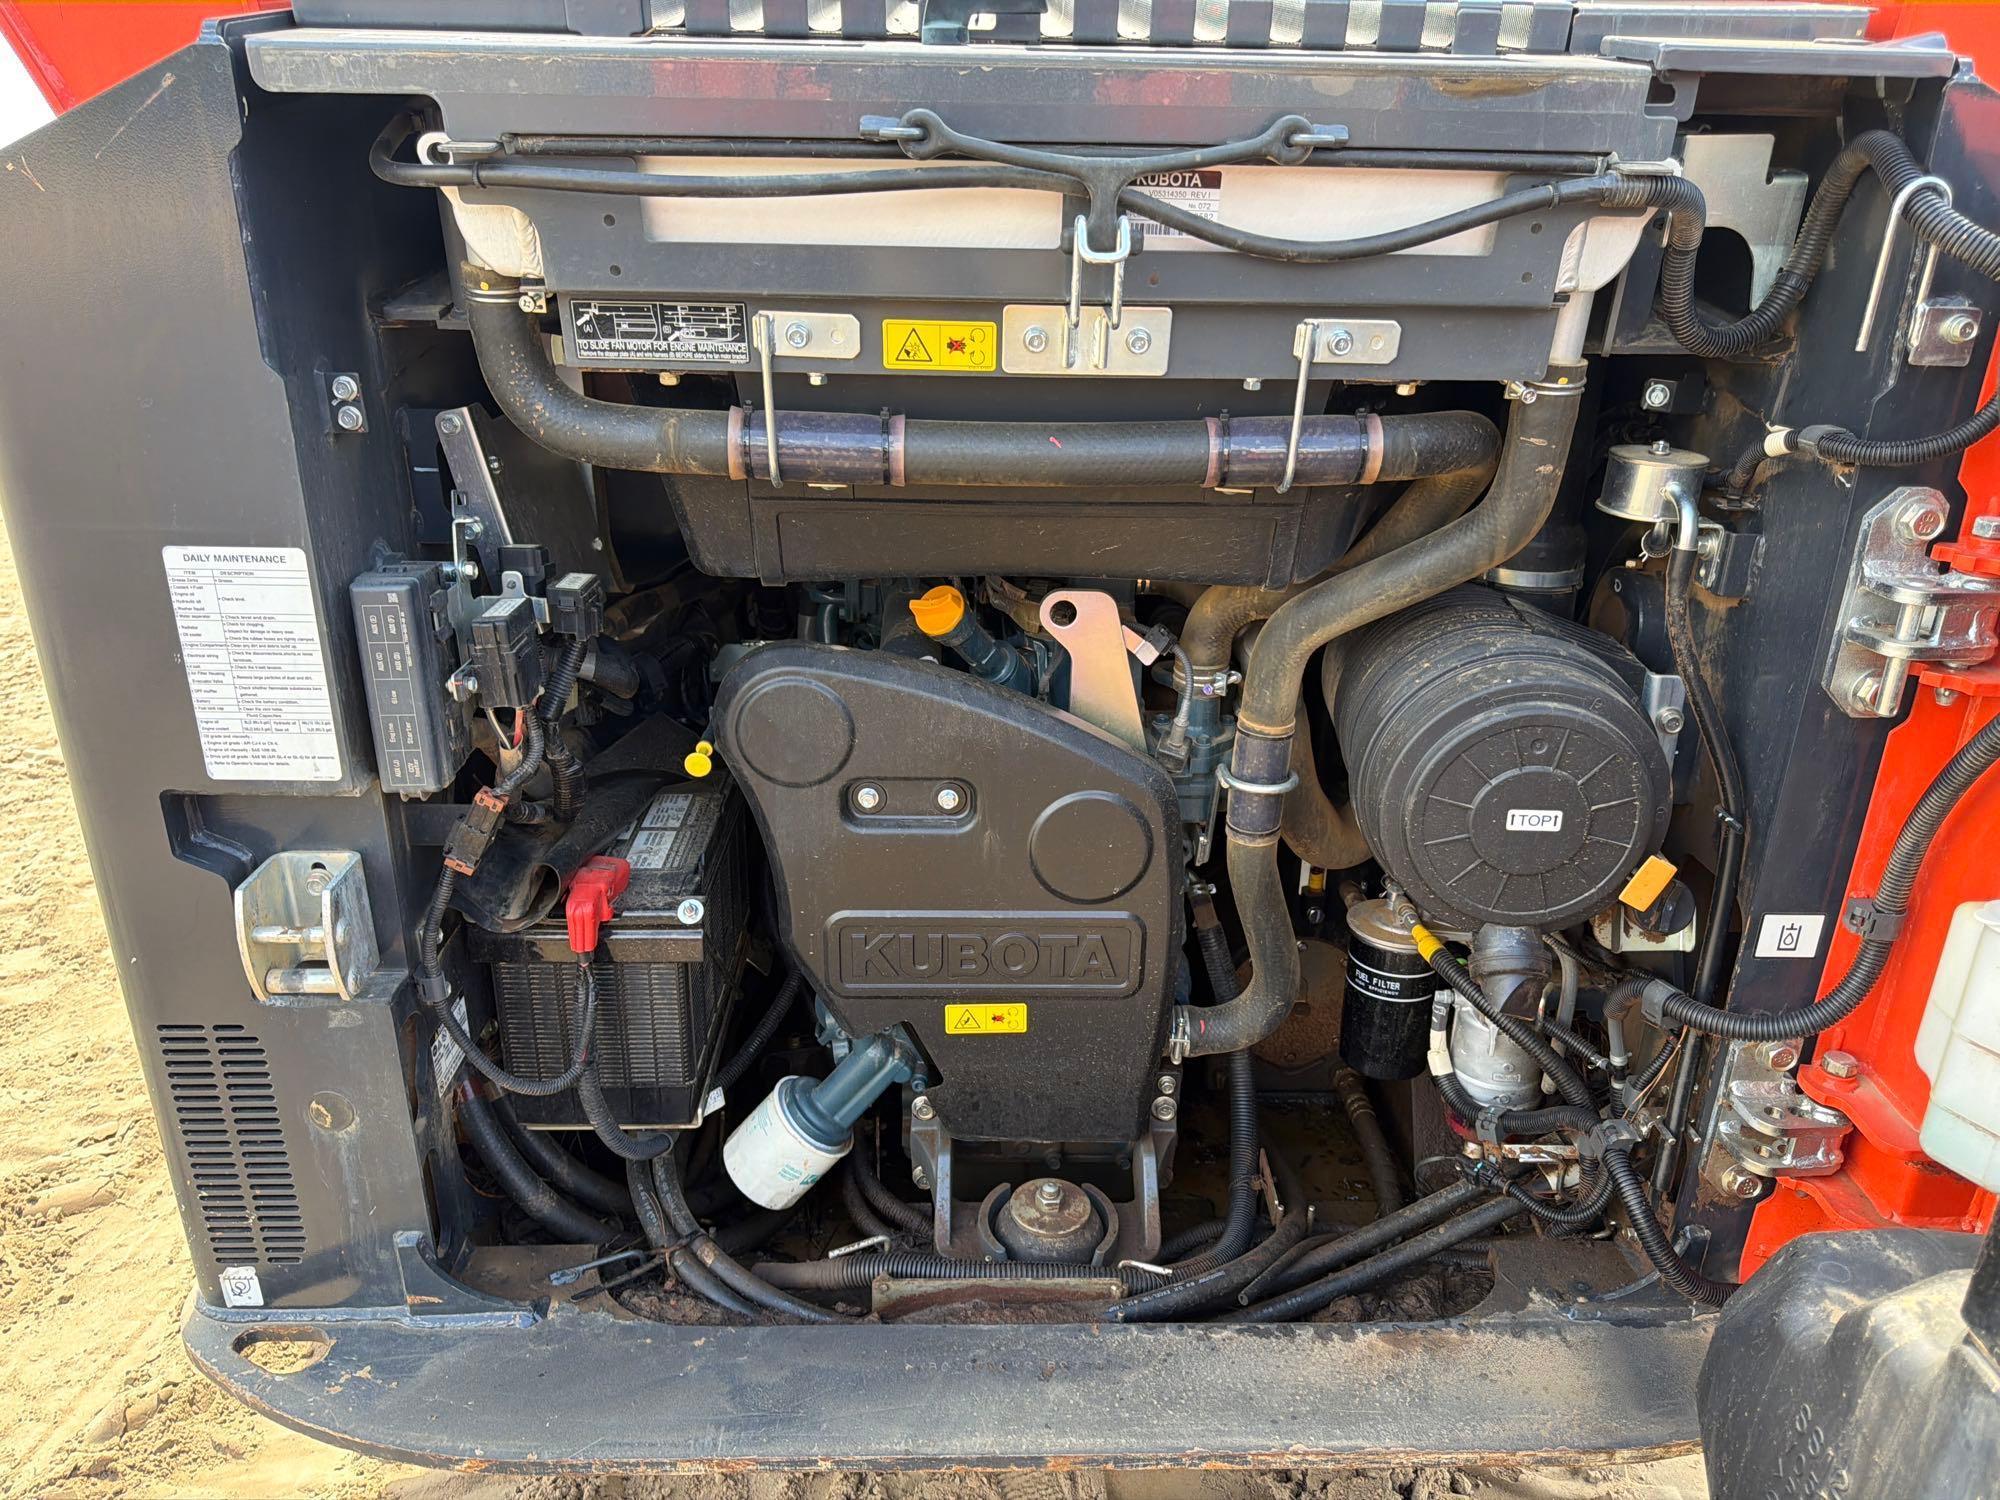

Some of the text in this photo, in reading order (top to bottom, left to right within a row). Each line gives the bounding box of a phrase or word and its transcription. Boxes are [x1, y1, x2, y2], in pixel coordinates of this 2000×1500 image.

[1136, 172, 1202, 187] KUBOTA
[579, 341, 747, 353] TO SLIDE FAN MOTOR FOR ENGINE MAINTENANCE
[183, 554, 287, 564] DAILY MAINTENANCE
[388, 722, 396, 743] Engine
[406, 722, 414, 744] Starter
[1519, 814, 1552, 826] TOP
[850, 932, 1117, 979] KUBOTA
[1355, 968, 1400, 991] FUEL FILTER
[1368, 985, 1399, 996] EFFICIENCY
